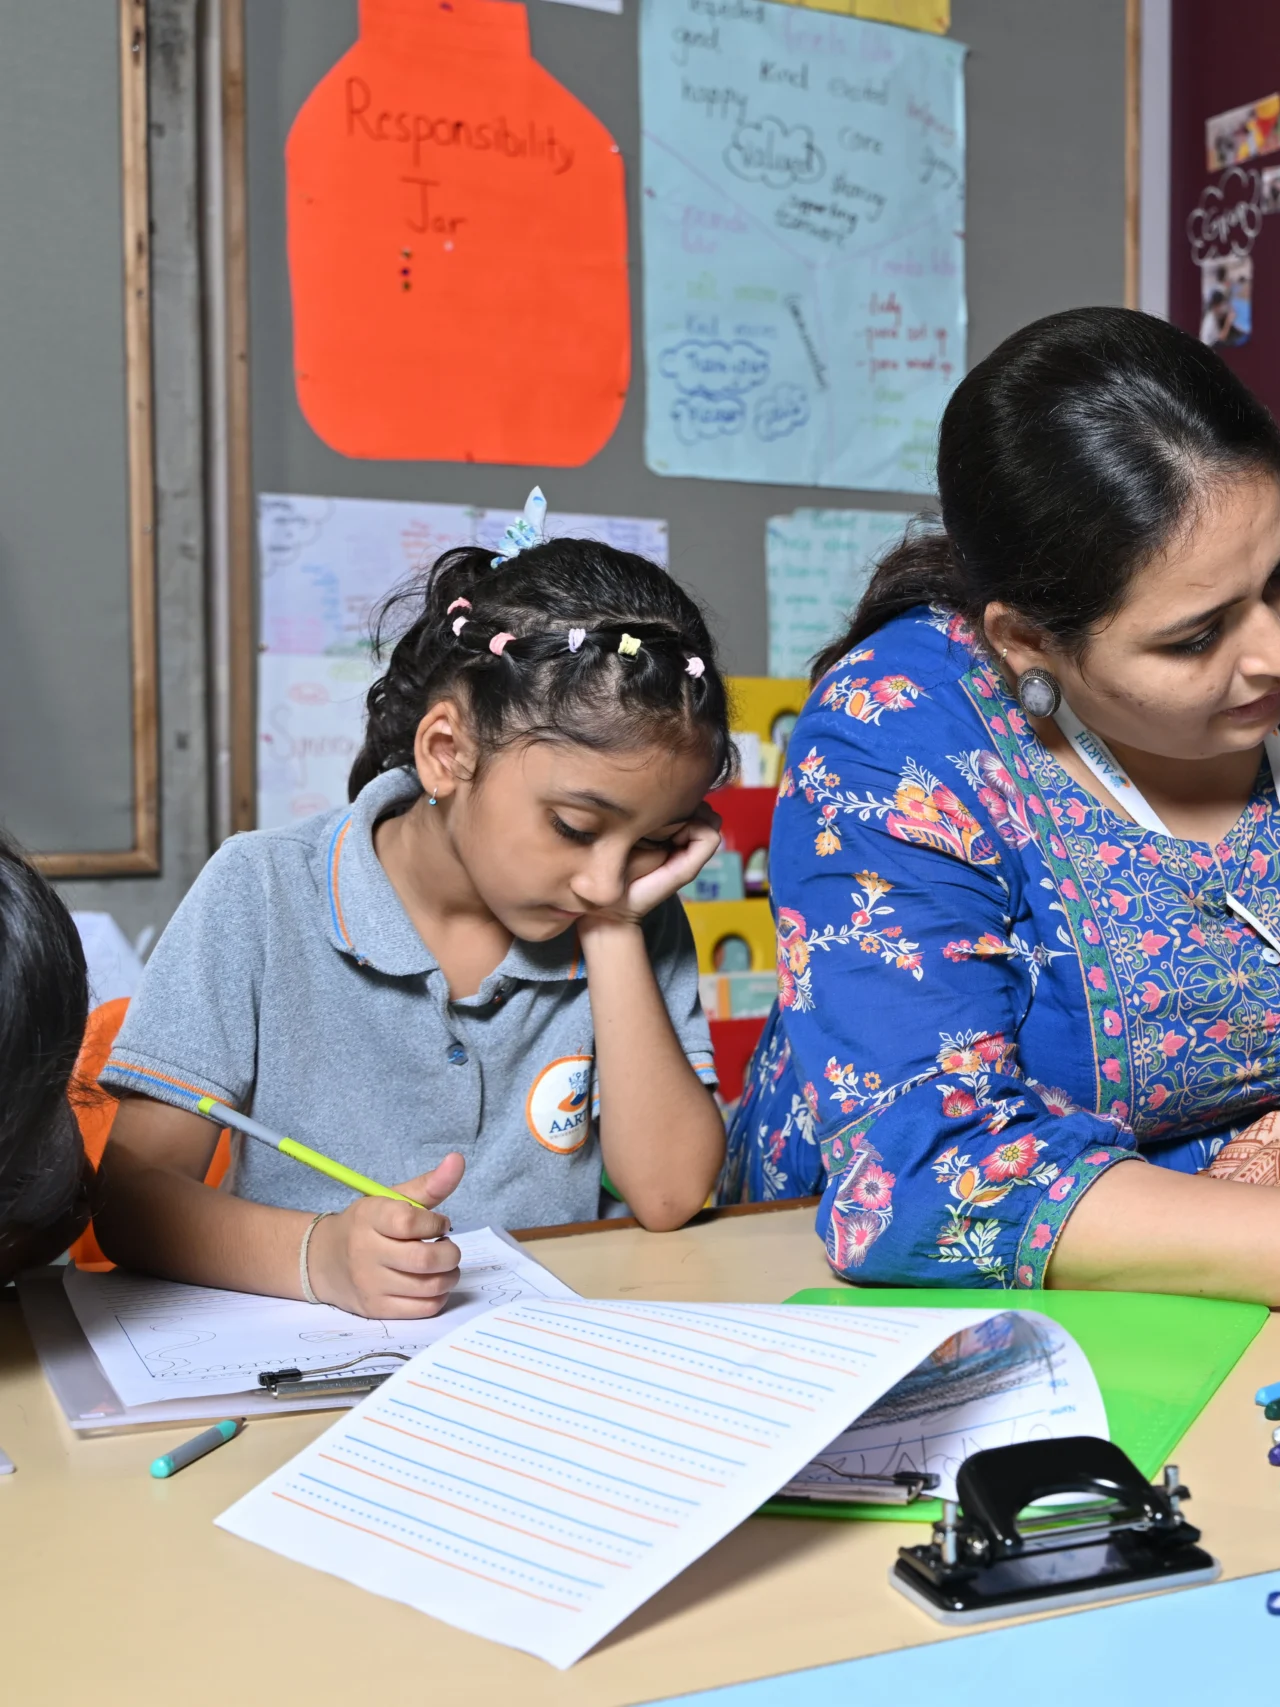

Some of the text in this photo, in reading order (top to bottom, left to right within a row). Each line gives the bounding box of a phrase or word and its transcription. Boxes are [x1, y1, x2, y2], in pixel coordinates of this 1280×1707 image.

[345, 75, 576, 175] Responsibility
[400, 175, 467, 235] Jar
[1074, 731, 1114, 774] AARTH
[549, 1109, 588, 1133] AART
